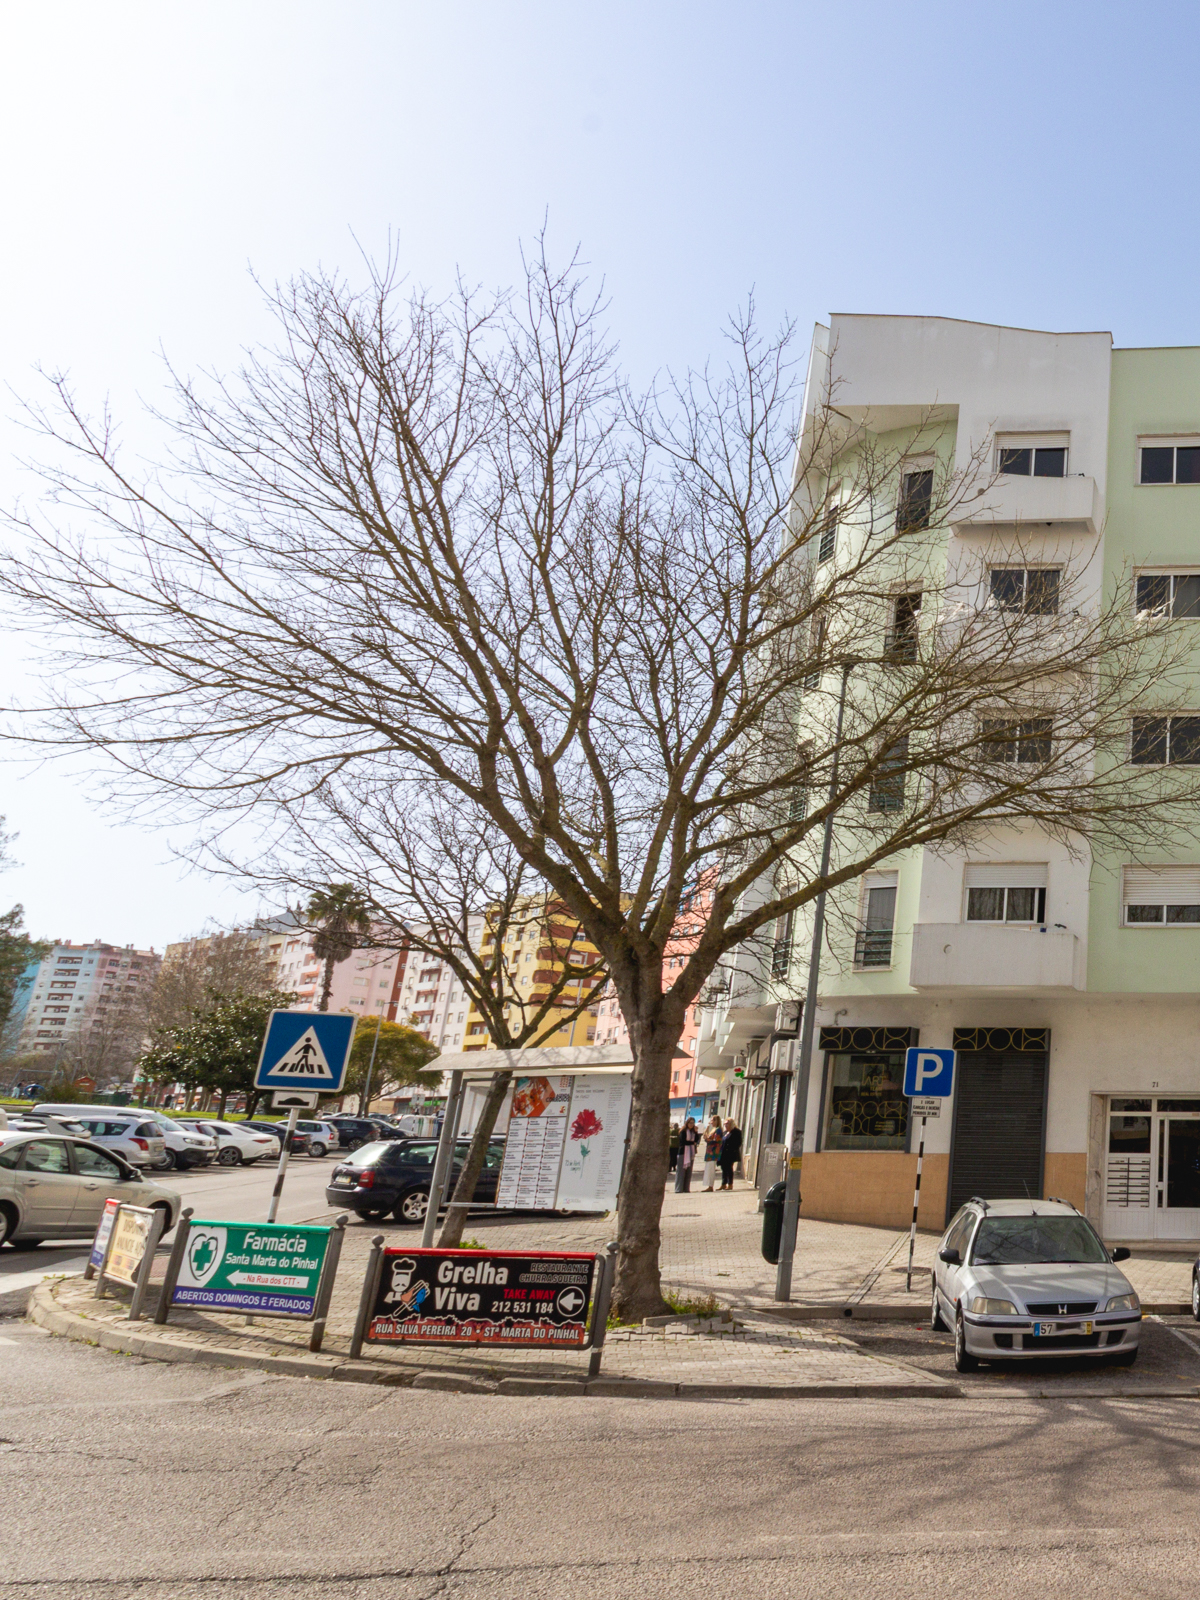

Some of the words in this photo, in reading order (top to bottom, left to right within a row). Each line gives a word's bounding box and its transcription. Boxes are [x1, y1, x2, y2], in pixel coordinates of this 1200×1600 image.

[914, 1052, 944, 1092] P
[242, 1231, 308, 1253] Farmácia
[225, 1252, 250, 1265] Santa
[252, 1255, 277, 1267] Marta
[279, 1257, 290, 1268] do
[291, 1257, 319, 1270] Pinhal
[530, 1262, 589, 1274] RESTAURANTE
[246, 1275, 255, 1283] Na
[256, 1275, 269, 1284] Rua
[270, 1276, 282, 1285] dos
[283, 1277, 297, 1286] CTT
[437, 1260, 509, 1285] Grelha
[519, 1273, 588, 1285] CHURRASQUEIRA
[175, 1290, 214, 1302] ABERTOS
[215, 1293, 260, 1306] DOMINGOS
[261, 1297, 267, 1306] E
[268, 1297, 312, 1311] FERIADOS
[434, 1287, 481, 1312] Viva
[503, 1288, 527, 1300] TAKE
[529, 1289, 556, 1301] AWAY
[491, 1301, 510, 1313] 212
[513, 1301, 531, 1314] 531
[535, 1302, 554, 1314] 184
[375, 1323, 393, 1334] RUA
[395, 1323, 419, 1335] SILVA
[420, 1325, 456, 1336] PEREIRA
[460, 1326, 472, 1336] 20
[501, 1327, 531, 1338] MARTA
[533, 1328, 546, 1339] DO
[547, 1328, 580, 1340] PINHAL
[1040, 1324, 1053, 1335] 57
